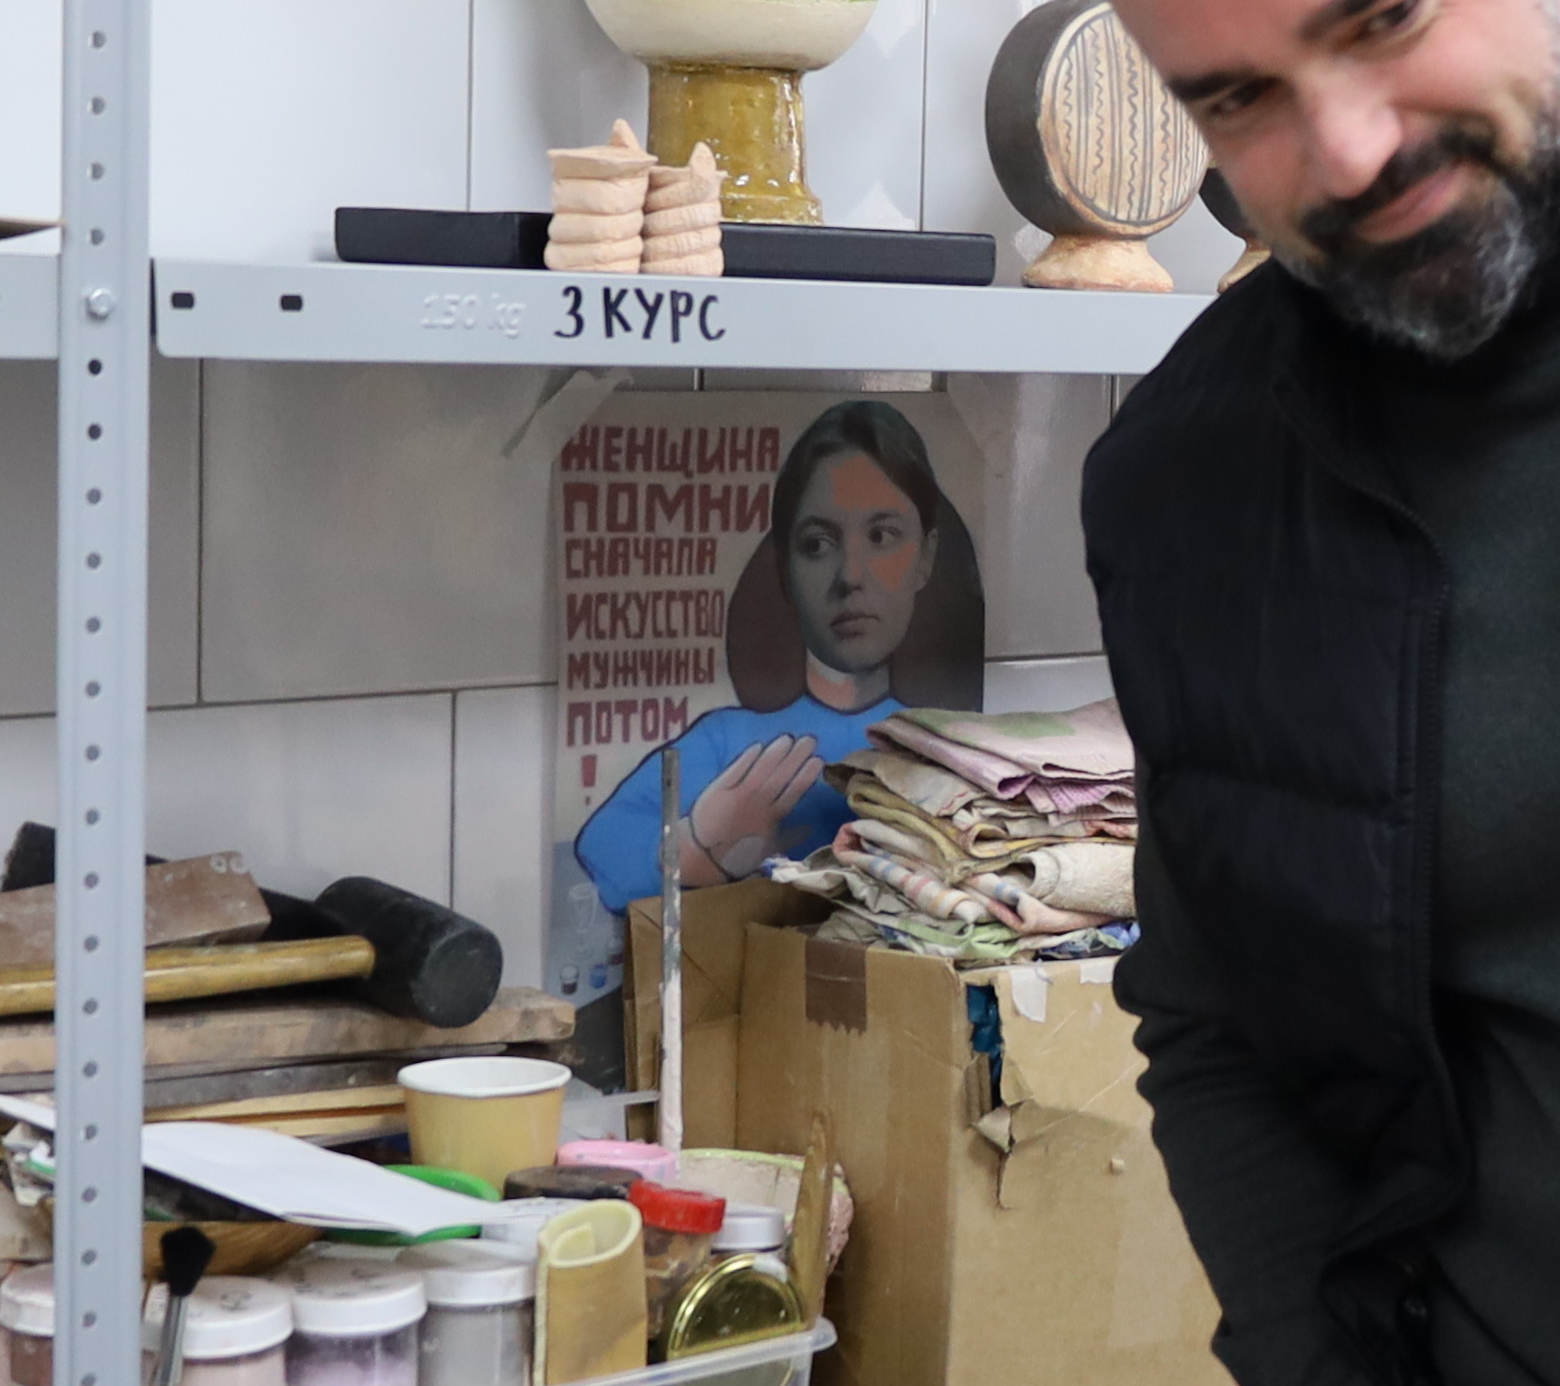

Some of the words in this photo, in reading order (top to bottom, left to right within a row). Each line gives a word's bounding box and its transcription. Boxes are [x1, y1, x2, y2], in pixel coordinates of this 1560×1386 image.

[553, 285, 585, 339] 3
[602, 285, 727, 344] КУРС
[560, 424, 780, 478] ЖЕНЩИНА
[563, 482, 772, 533] ПОМНИ
[565, 536, 717, 579] СНАЧАЛА
[566, 588, 725, 641] ИСКУССТВО
[567, 647, 715, 690] МУЖЧИНЫ
[566, 696, 689, 747] ПОТОМ
